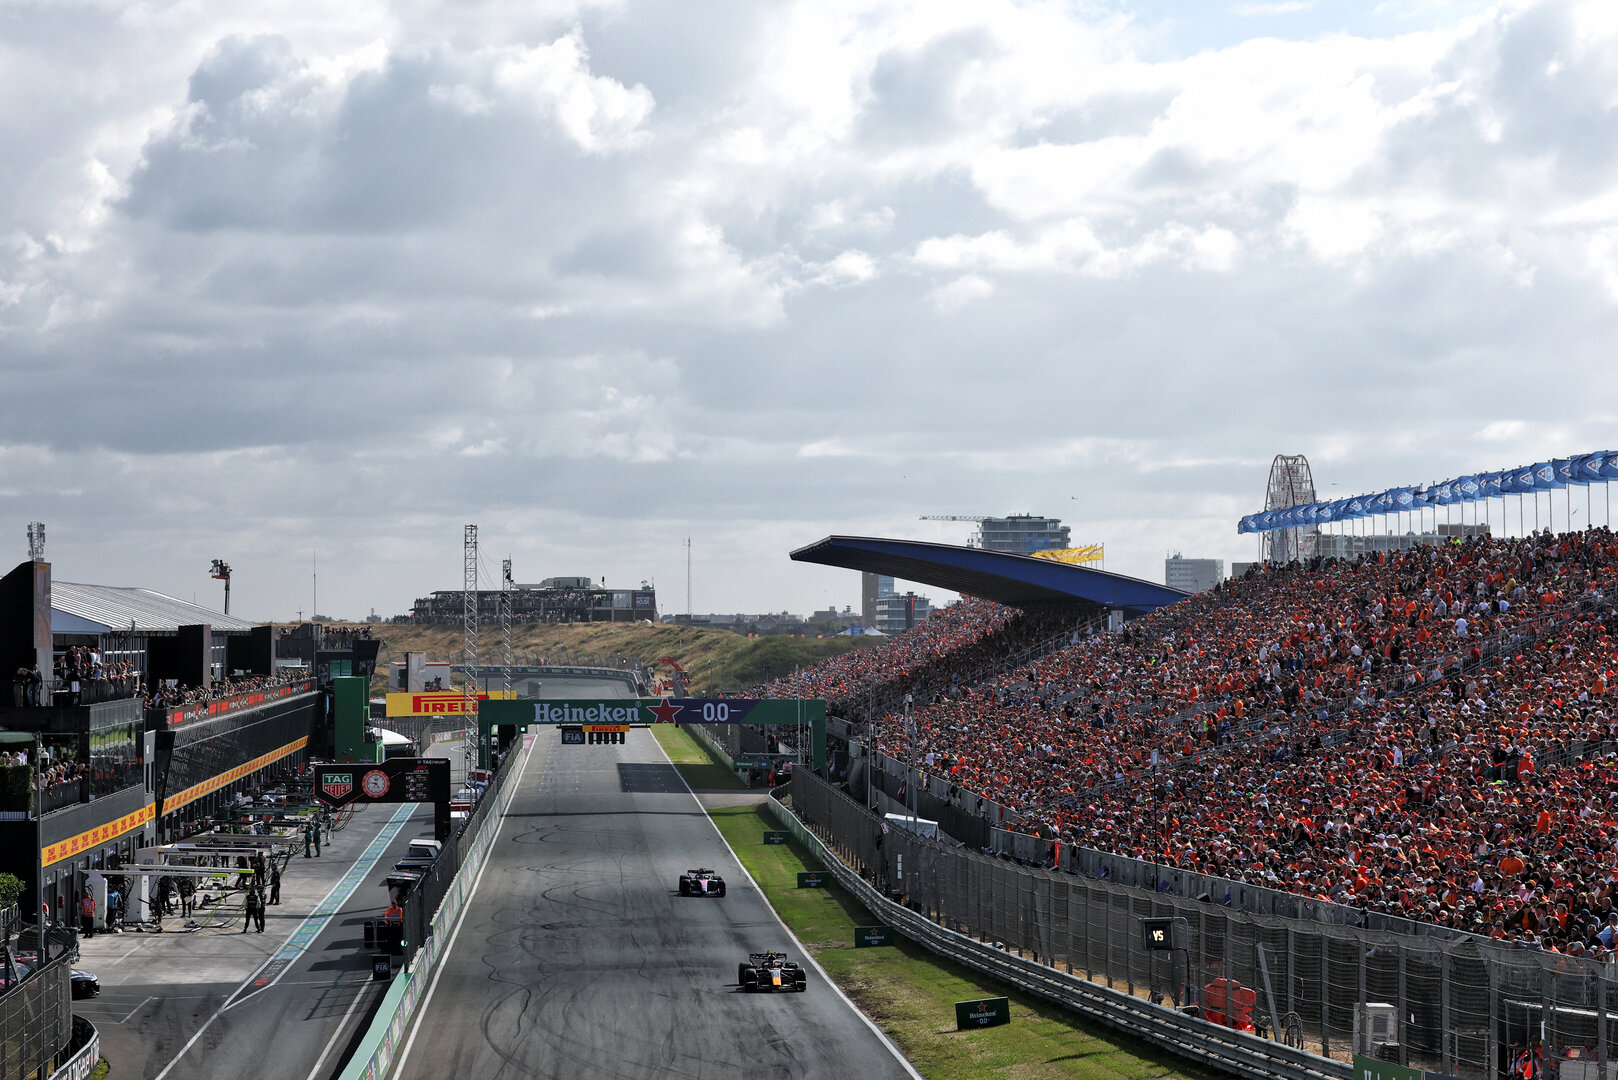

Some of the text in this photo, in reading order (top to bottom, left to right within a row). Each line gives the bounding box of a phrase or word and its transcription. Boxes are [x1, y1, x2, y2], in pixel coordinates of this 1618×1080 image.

[534, 702, 729, 722] Heineken 0.0
[564, 732, 581, 741] FIA
[325, 775, 350, 783] TAG
[324, 785, 351, 797] HEUER
[375, 963, 388, 971] FIA
[969, 1011, 997, 1019] Heineken
